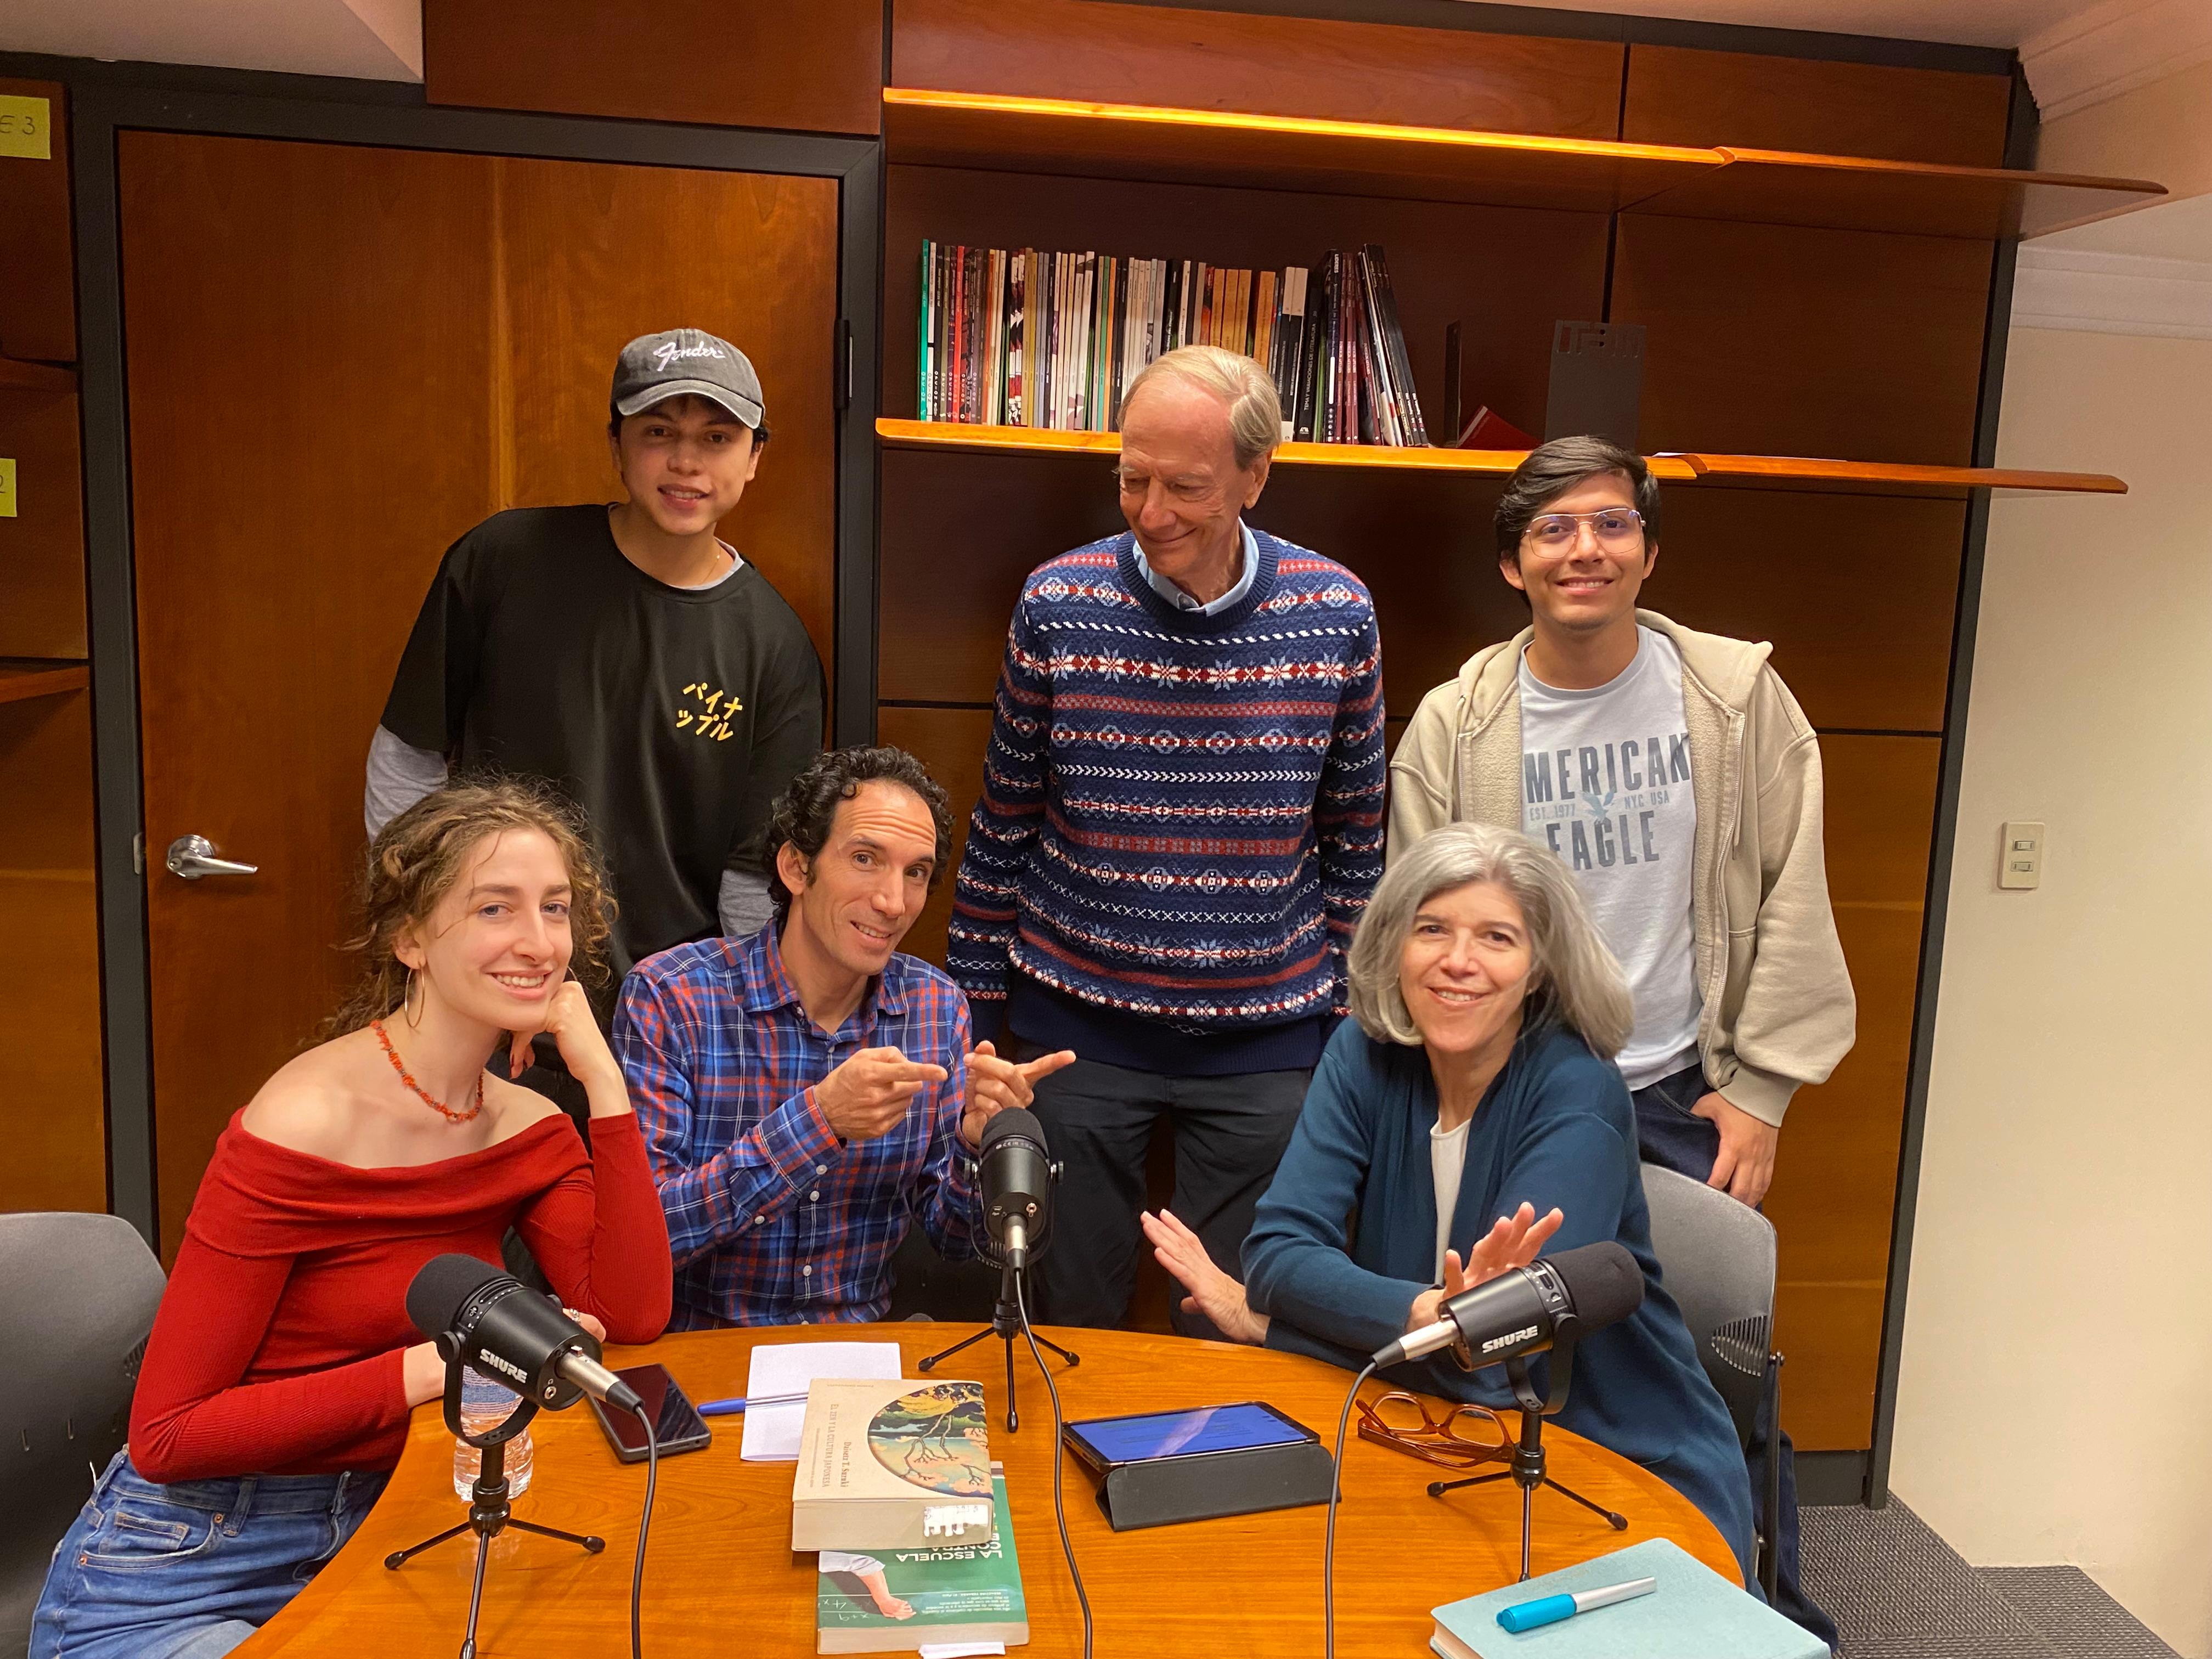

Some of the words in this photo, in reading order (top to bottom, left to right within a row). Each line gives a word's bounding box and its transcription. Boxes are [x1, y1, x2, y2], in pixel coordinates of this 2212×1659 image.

[653, 340, 725, 371] Fender
[682, 682, 743, 720] パイナ
[676, 709, 733, 741] ップル
[1523, 732, 1691, 803] MERICAN
[1554, 804, 1576, 819] 1977
[1624, 795, 1644, 809] NYC
[1650, 790, 1670, 806] USA
[1545, 810, 1660, 871] EAGLE
[1482, 1325, 1538, 1354] SHURE
[479, 1348, 528, 1384] SHURE
[825, 1434, 834, 1458] CULTURA
[822, 1459, 832, 1487] JAPONESA
[840, 1469, 849, 1487] Suzuki
[895, 1551, 975, 1562] ESCUELA
[979, 1549, 1002, 1559] LA
